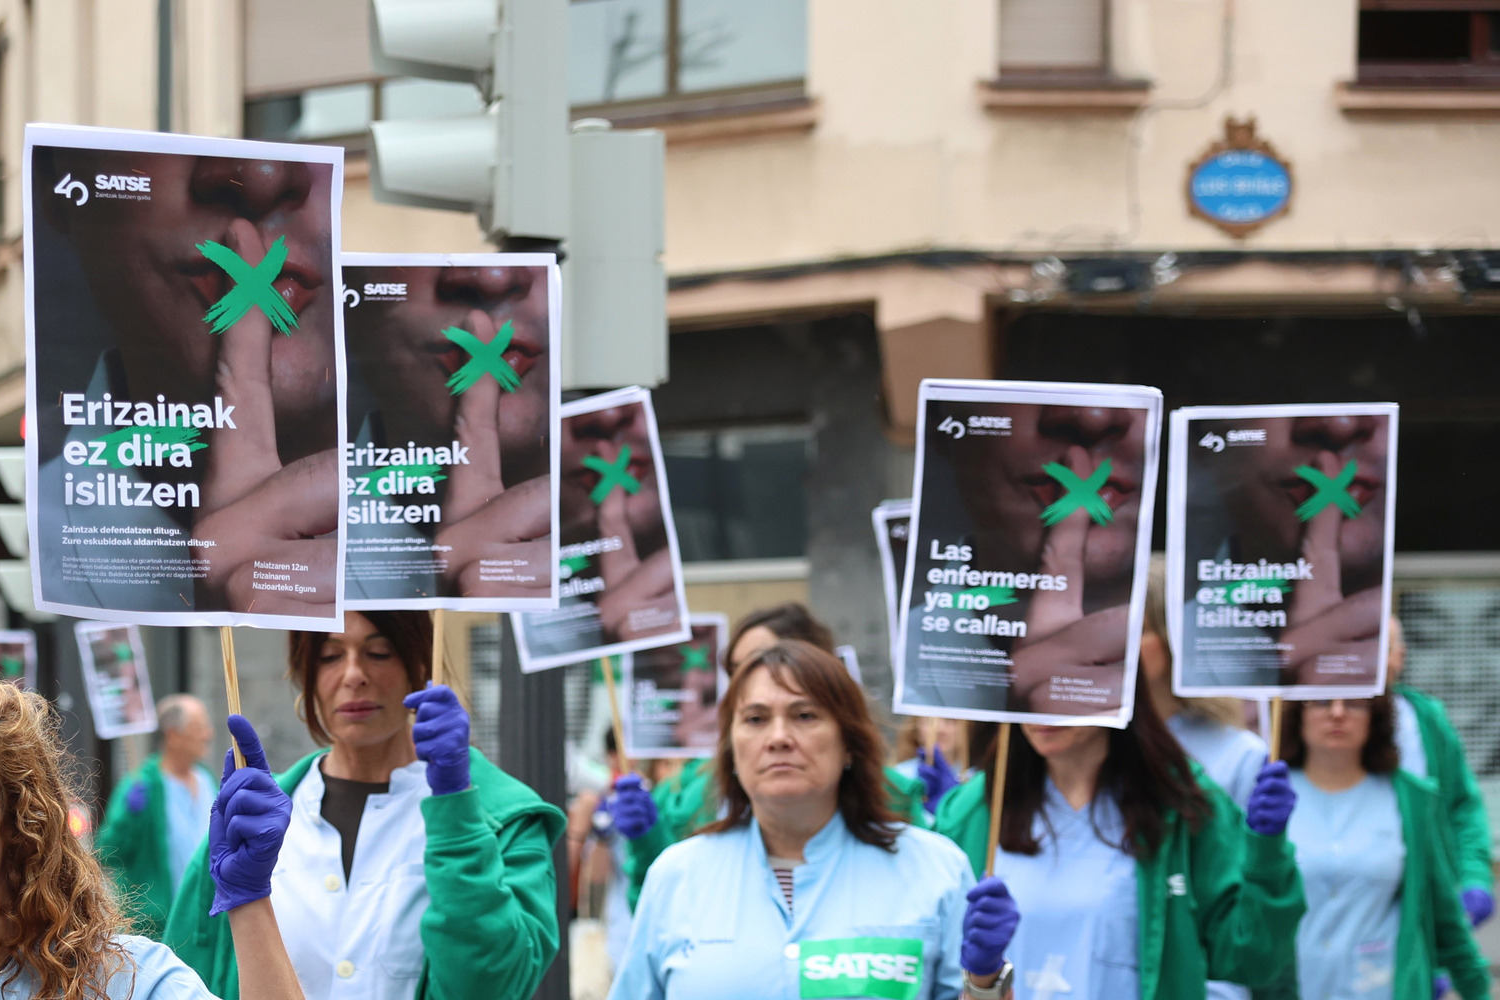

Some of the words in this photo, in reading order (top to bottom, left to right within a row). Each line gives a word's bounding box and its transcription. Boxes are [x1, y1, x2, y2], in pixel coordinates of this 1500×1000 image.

[95, 174, 151, 193] SATSE
[363, 283, 407, 295] SATSE
[63, 393, 237, 429] Erizainak
[967, 415, 1013, 430] SATSE
[63, 440, 107, 466] ez
[117, 434, 192, 468] dira
[347, 440, 470, 466] Erizainak
[64, 473, 200, 508] isiltzen
[347, 477, 371, 495] ez
[377, 470, 435, 495] dira
[347, 500, 441, 524] siltzen
[62, 525, 98, 535] Zaintzak
[100, 526, 151, 536] defendatzen
[153, 527, 182, 537] ditugu.
[62, 537, 81, 546] Zure
[83, 537, 132, 547] eskubideak
[133, 538, 186, 548] aldarrikatzen
[187, 538, 217, 549] ditugu.
[930, 539, 972, 561] Las
[253, 571, 291, 582] Erizainaren
[254, 560, 290, 571] Maiatzaren
[291, 562, 309, 572] 12an
[1197, 558, 1314, 581] Erizainak
[252, 582, 293, 592] Nazioarteko
[294, 584, 317, 595] Eguna
[927, 564, 1068, 591] enfermeras
[924, 593, 953, 612] ya
[958, 593, 990, 610] no
[1196, 587, 1227, 604] ez
[1230, 582, 1283, 604] dira
[921, 615, 950, 632] se
[954, 615, 1027, 638] callan
[1196, 607, 1286, 628] isiltzen
[803, 952, 918, 984] SATSE
